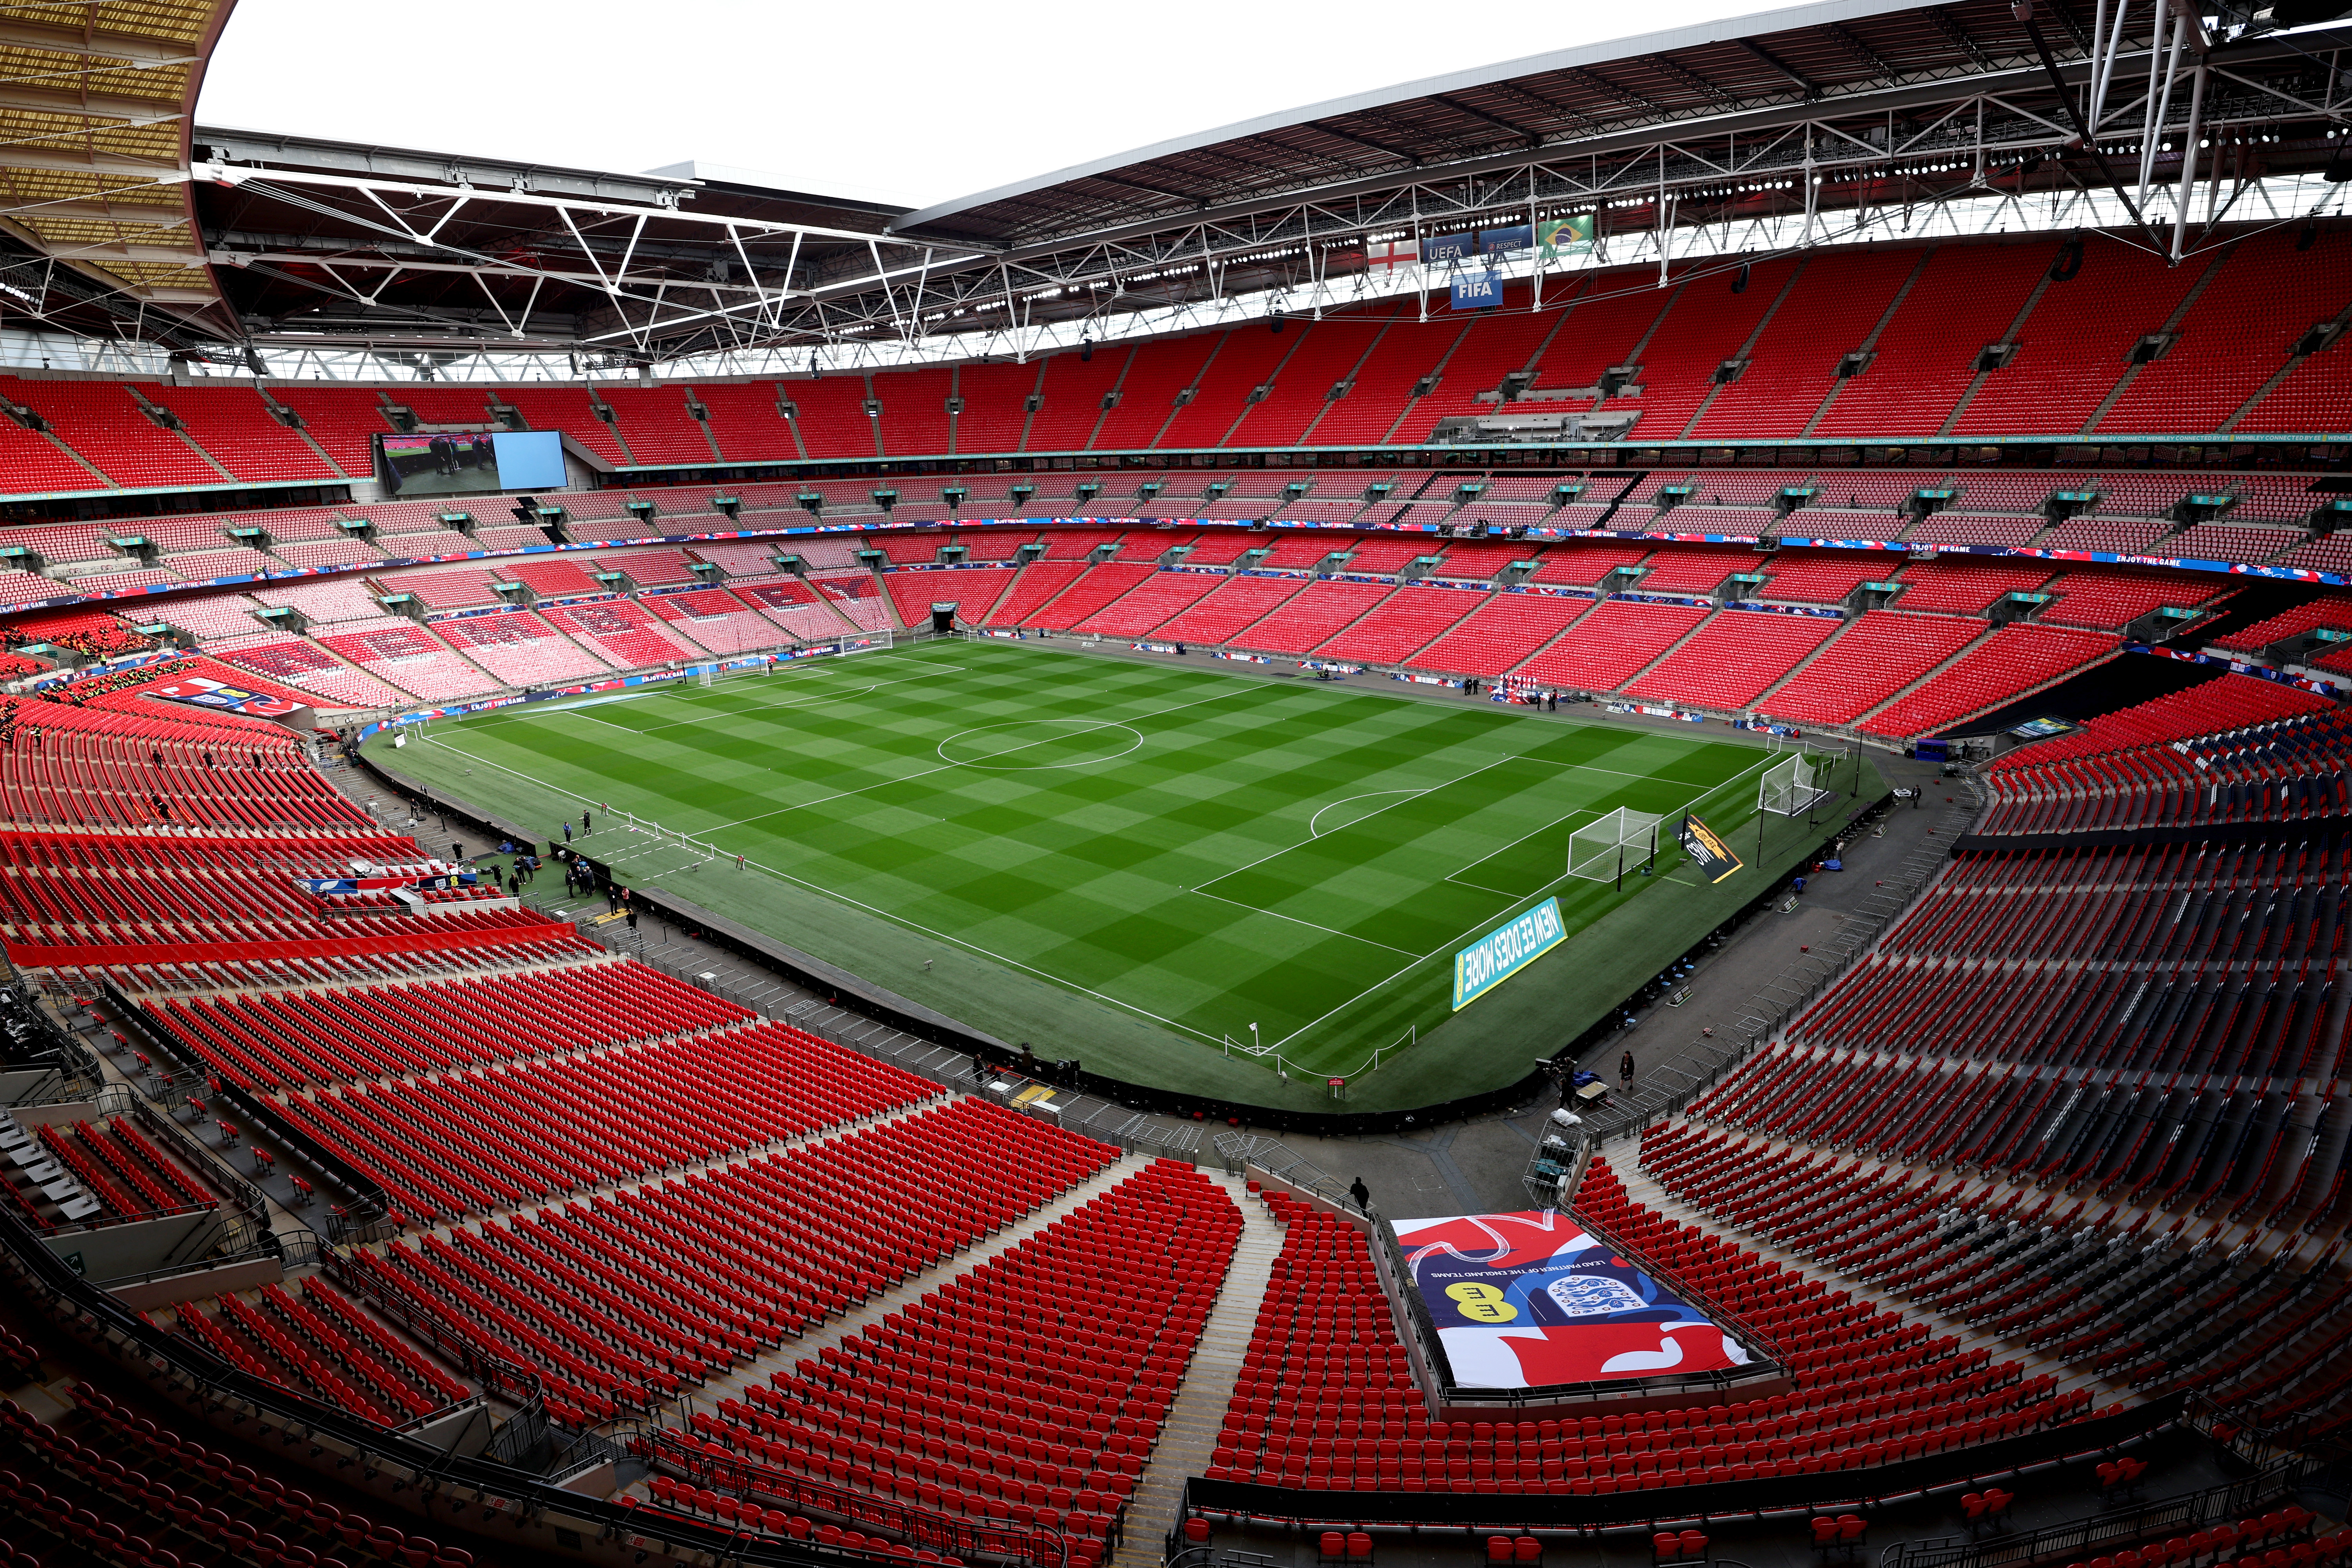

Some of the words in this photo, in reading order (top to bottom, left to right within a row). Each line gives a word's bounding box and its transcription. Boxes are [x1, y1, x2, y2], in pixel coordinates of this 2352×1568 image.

[1496, 240, 1522, 249] RESPECT
[1430, 245, 1462, 260] UEFA
[1459, 281, 1492, 298] FIFA
[2116, 555, 2141, 564] ENJOY
[2159, 558, 2181, 566] GAME
[166, 583, 185, 591] ENJOY
[31, 601, 48, 610] GAME
[2230, 661, 2245, 672] ENGLAND
[672, 670, 688, 679] GAME
[471, 701, 492, 711] ENJOY
[493, 699, 506, 708] THE
[507, 696, 526, 706] GAME
[1656, 708, 1670, 717] ENGLAND
[1686, 839, 1714, 866] M&S
[452, 877, 456, 886] EE
[1534, 903, 1560, 944] NEW
[1519, 916, 1536, 954] EE
[1495, 924, 1522, 971] DOES
[1465, 939, 1495, 992] MORE
[1542, 1263, 1582, 1272] PARTNER
[1463, 1287, 1500, 1316] EE
